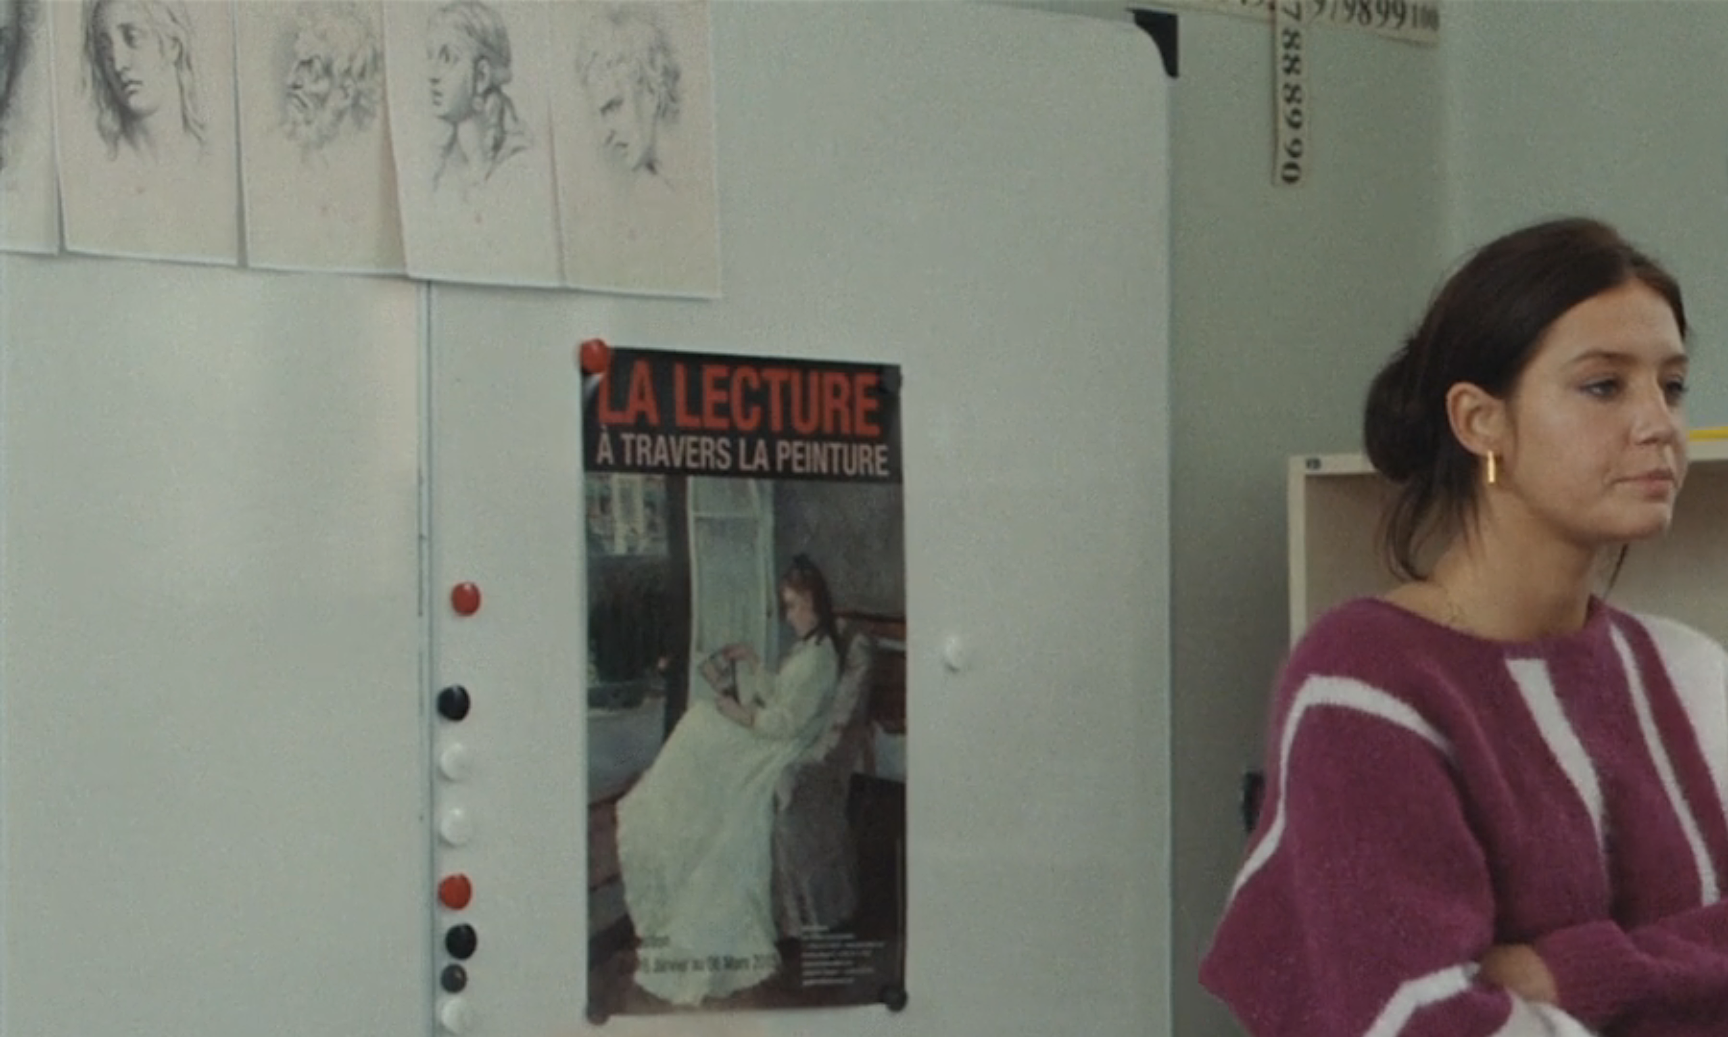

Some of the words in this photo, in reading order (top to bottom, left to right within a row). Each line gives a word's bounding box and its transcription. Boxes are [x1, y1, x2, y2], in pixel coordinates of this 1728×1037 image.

[597, 358, 661, 427] LA
[673, 361, 882, 436] LECTURE
[595, 424, 615, 466] À
[620, 431, 732, 470] TRAVERS
[739, 438, 769, 471] LA
[775, 440, 890, 476] PEINTURE
